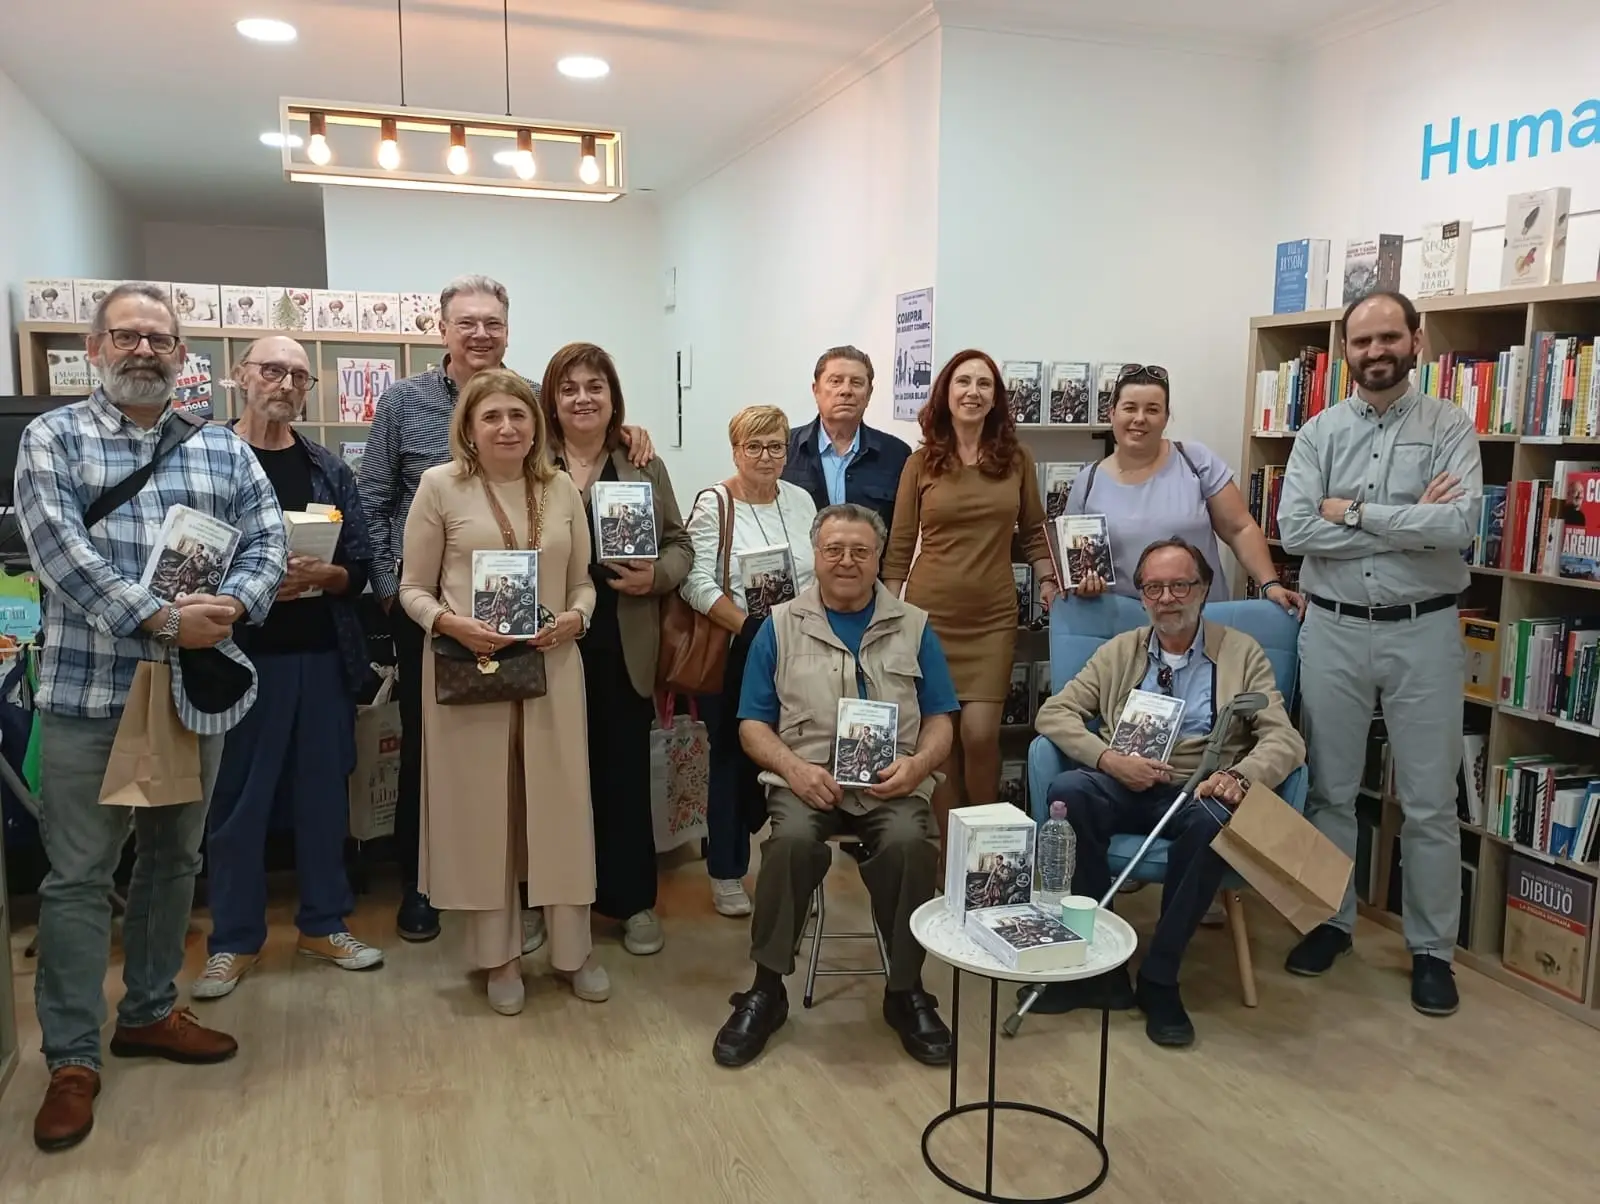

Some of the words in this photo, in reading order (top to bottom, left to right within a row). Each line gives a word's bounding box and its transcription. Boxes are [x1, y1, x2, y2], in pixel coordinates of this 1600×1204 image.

[897, 309, 922, 325] COMPRA
[177, 374, 208, 386] ERRA
[342, 370, 392, 398] YOGA
[1563, 533, 1600, 555] ARGUI
[1520, 876, 1572, 914] DIBUJO
